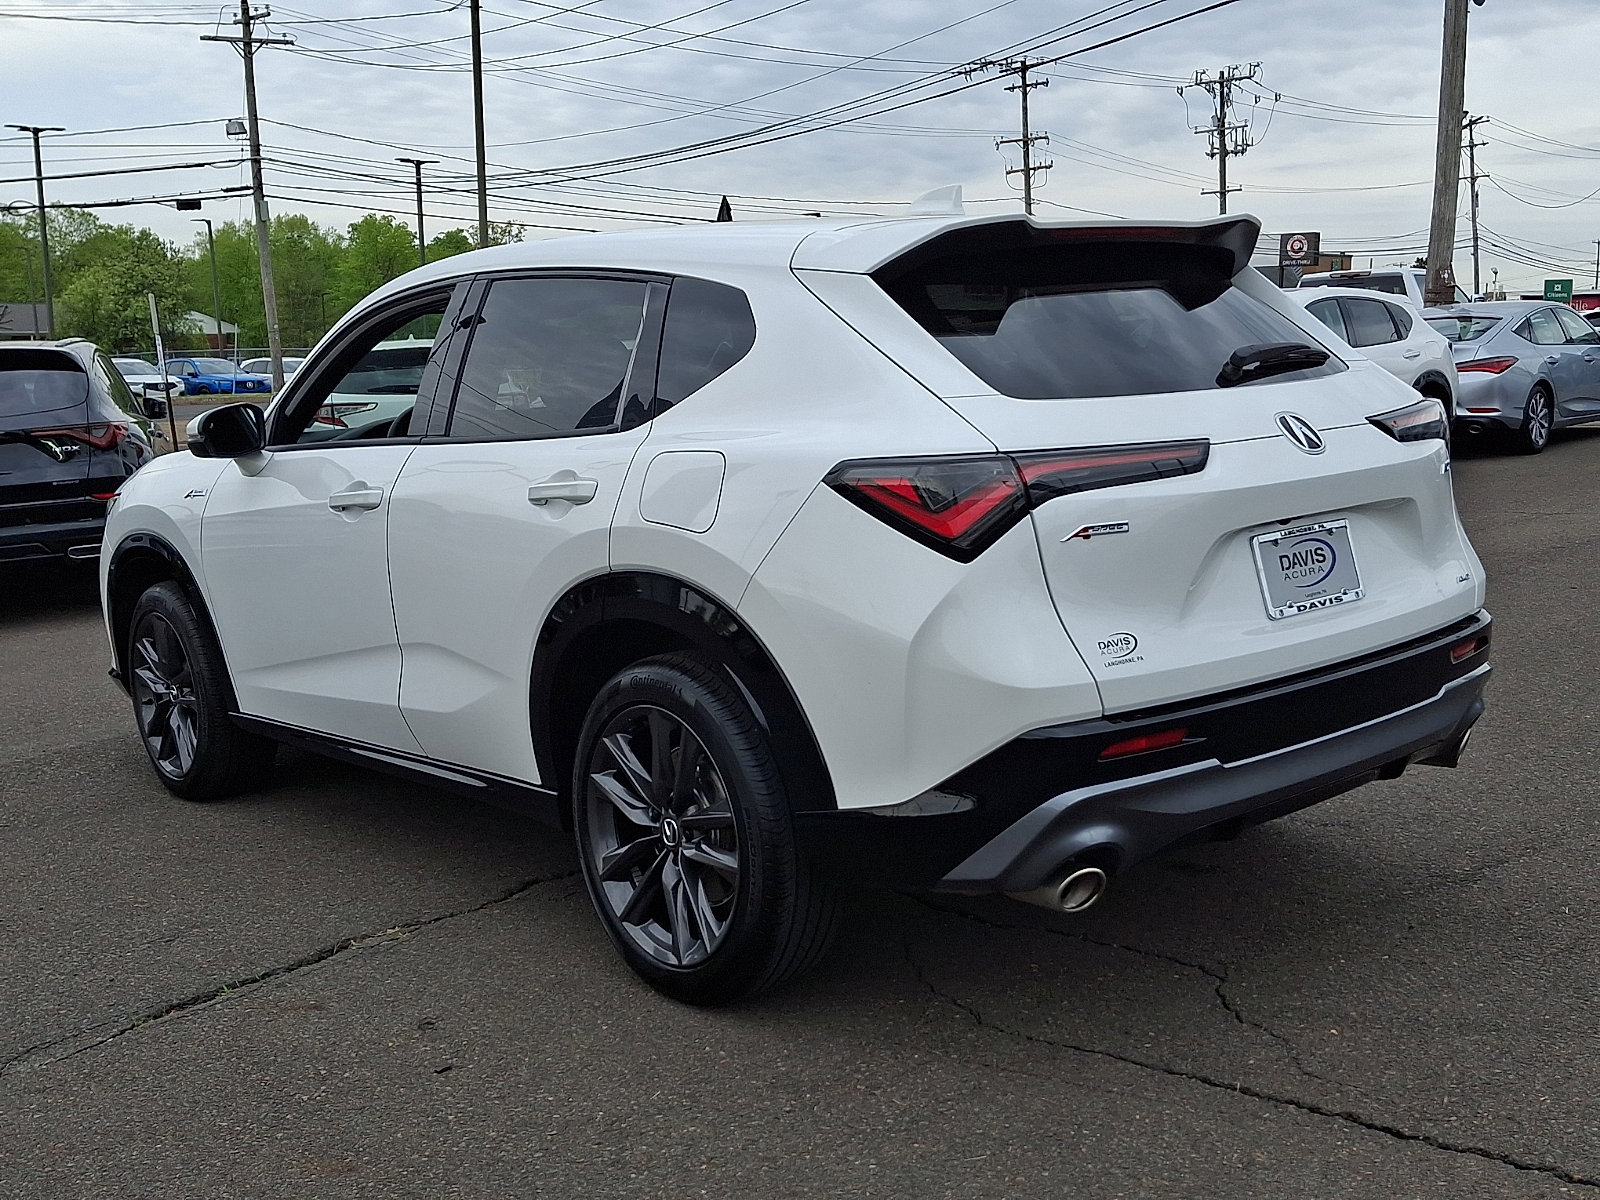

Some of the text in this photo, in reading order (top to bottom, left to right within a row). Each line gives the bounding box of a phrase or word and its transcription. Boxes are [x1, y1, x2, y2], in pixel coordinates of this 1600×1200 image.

[1279, 547, 1327, 572] DAVIS
[1284, 565, 1325, 581] ACURA
[1296, 595, 1344, 613] DAVIS
[1098, 636, 1131, 650] DAVIS
[1101, 646, 1131, 656] ACURA
[630, 675, 677, 693] Continental
